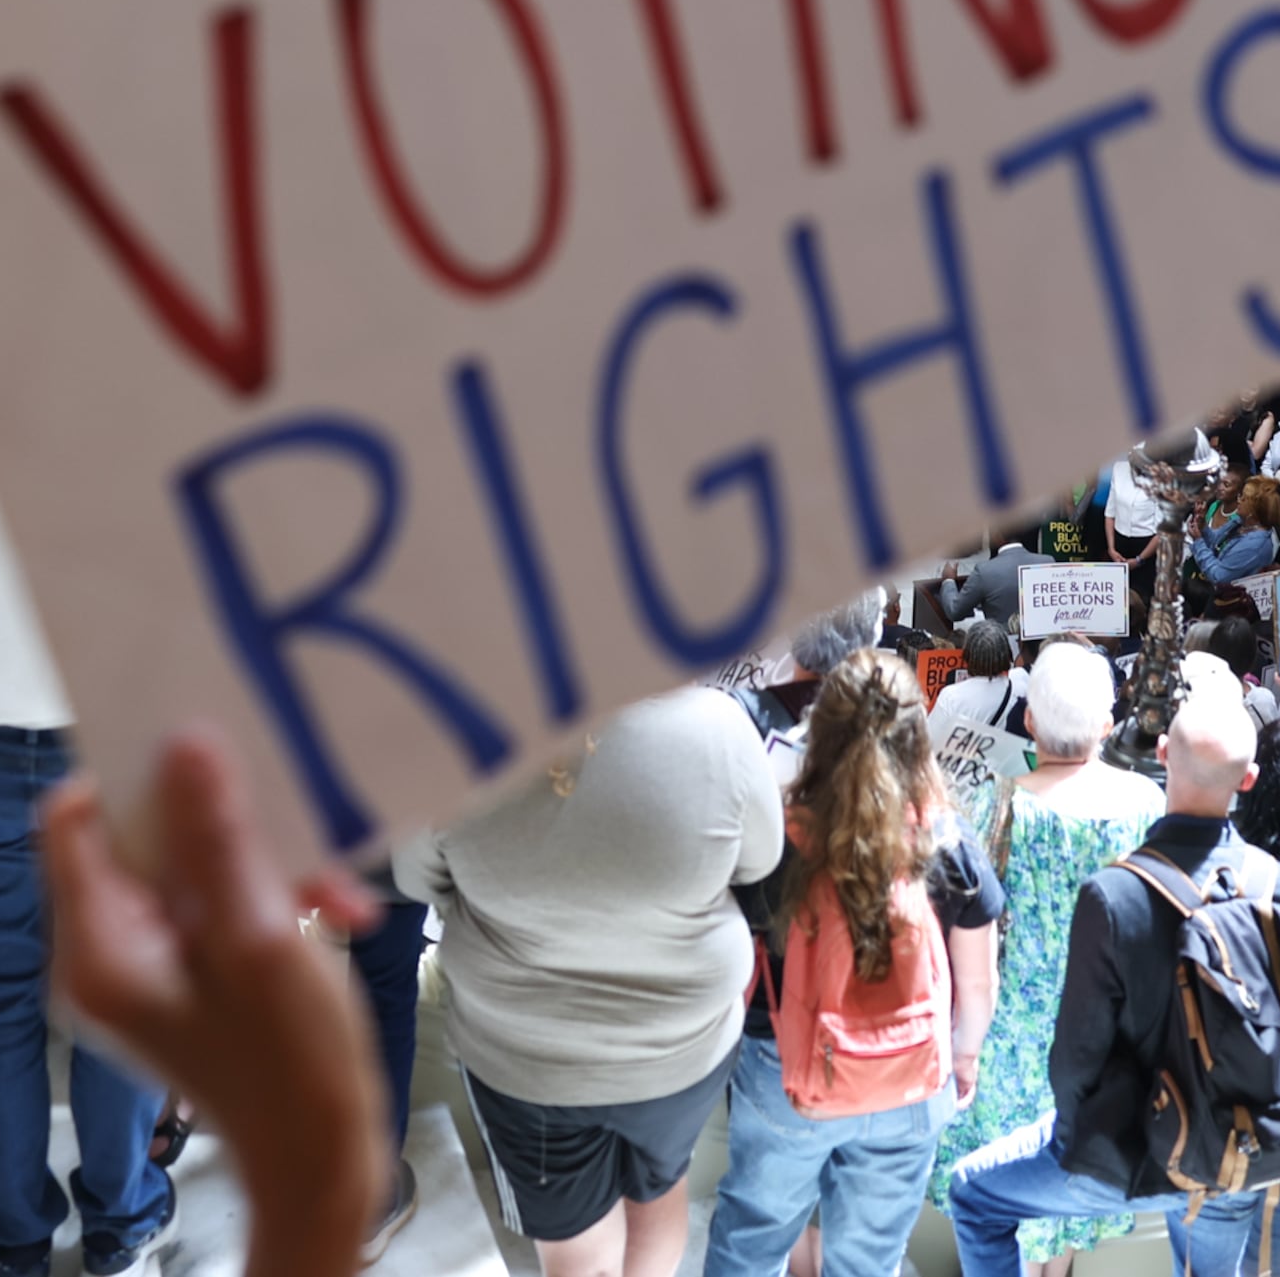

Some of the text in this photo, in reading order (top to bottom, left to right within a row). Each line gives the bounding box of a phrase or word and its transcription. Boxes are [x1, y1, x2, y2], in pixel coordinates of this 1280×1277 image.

[1032, 581, 1114, 594] FREE & FAIR
[1032, 594, 1114, 608] ELECTIONS
[1053, 608, 1071, 624] for
[945, 726, 995, 760] FAIR
